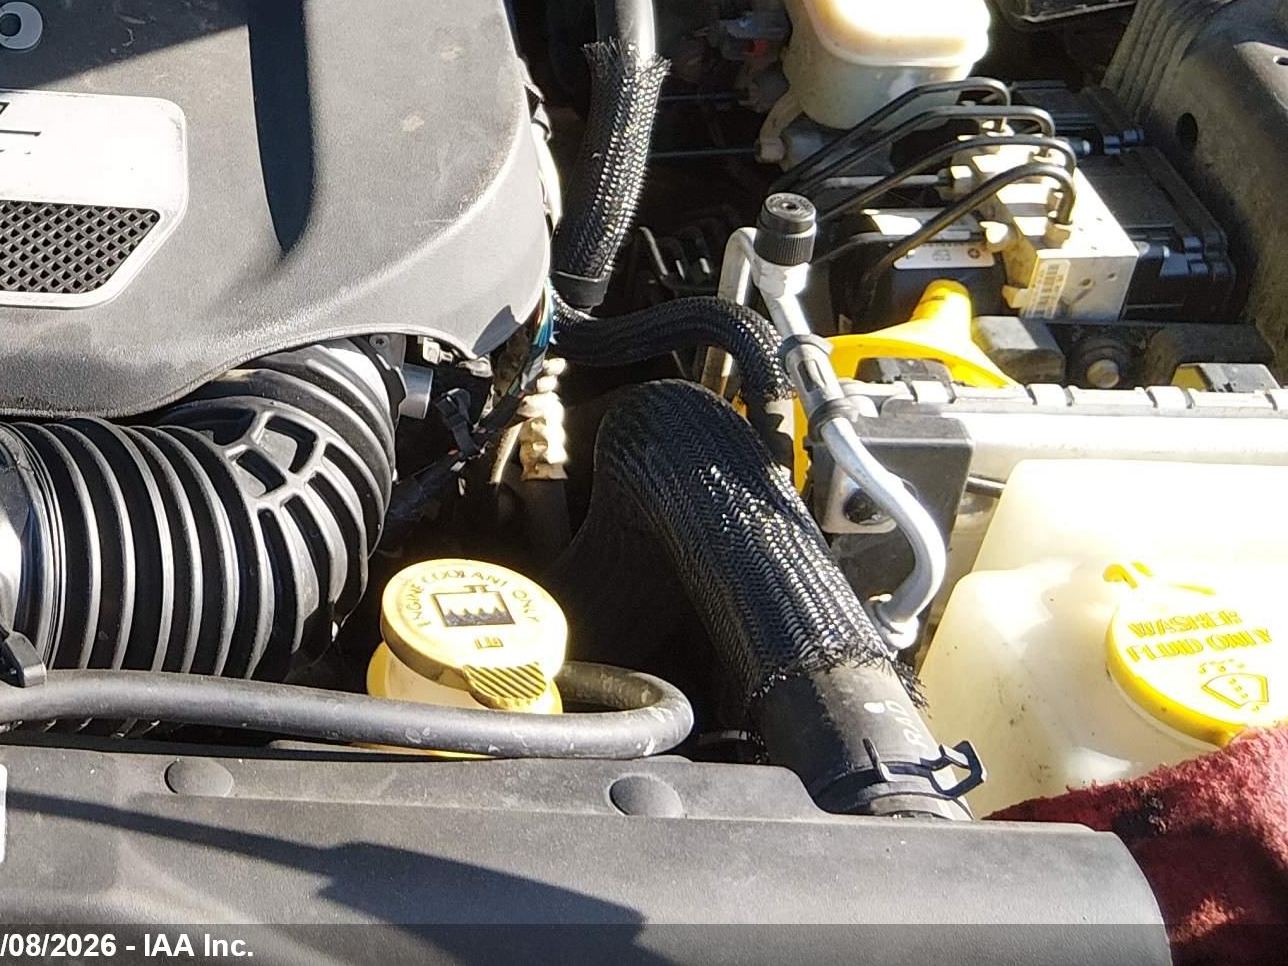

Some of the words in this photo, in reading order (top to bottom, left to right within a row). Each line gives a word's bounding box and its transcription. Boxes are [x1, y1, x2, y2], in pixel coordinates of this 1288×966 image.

[1127, 610, 1243, 638] WASHER
[1126, 638, 1204, 663] FLUID
[1205, 628, 1272, 651] ONLY
